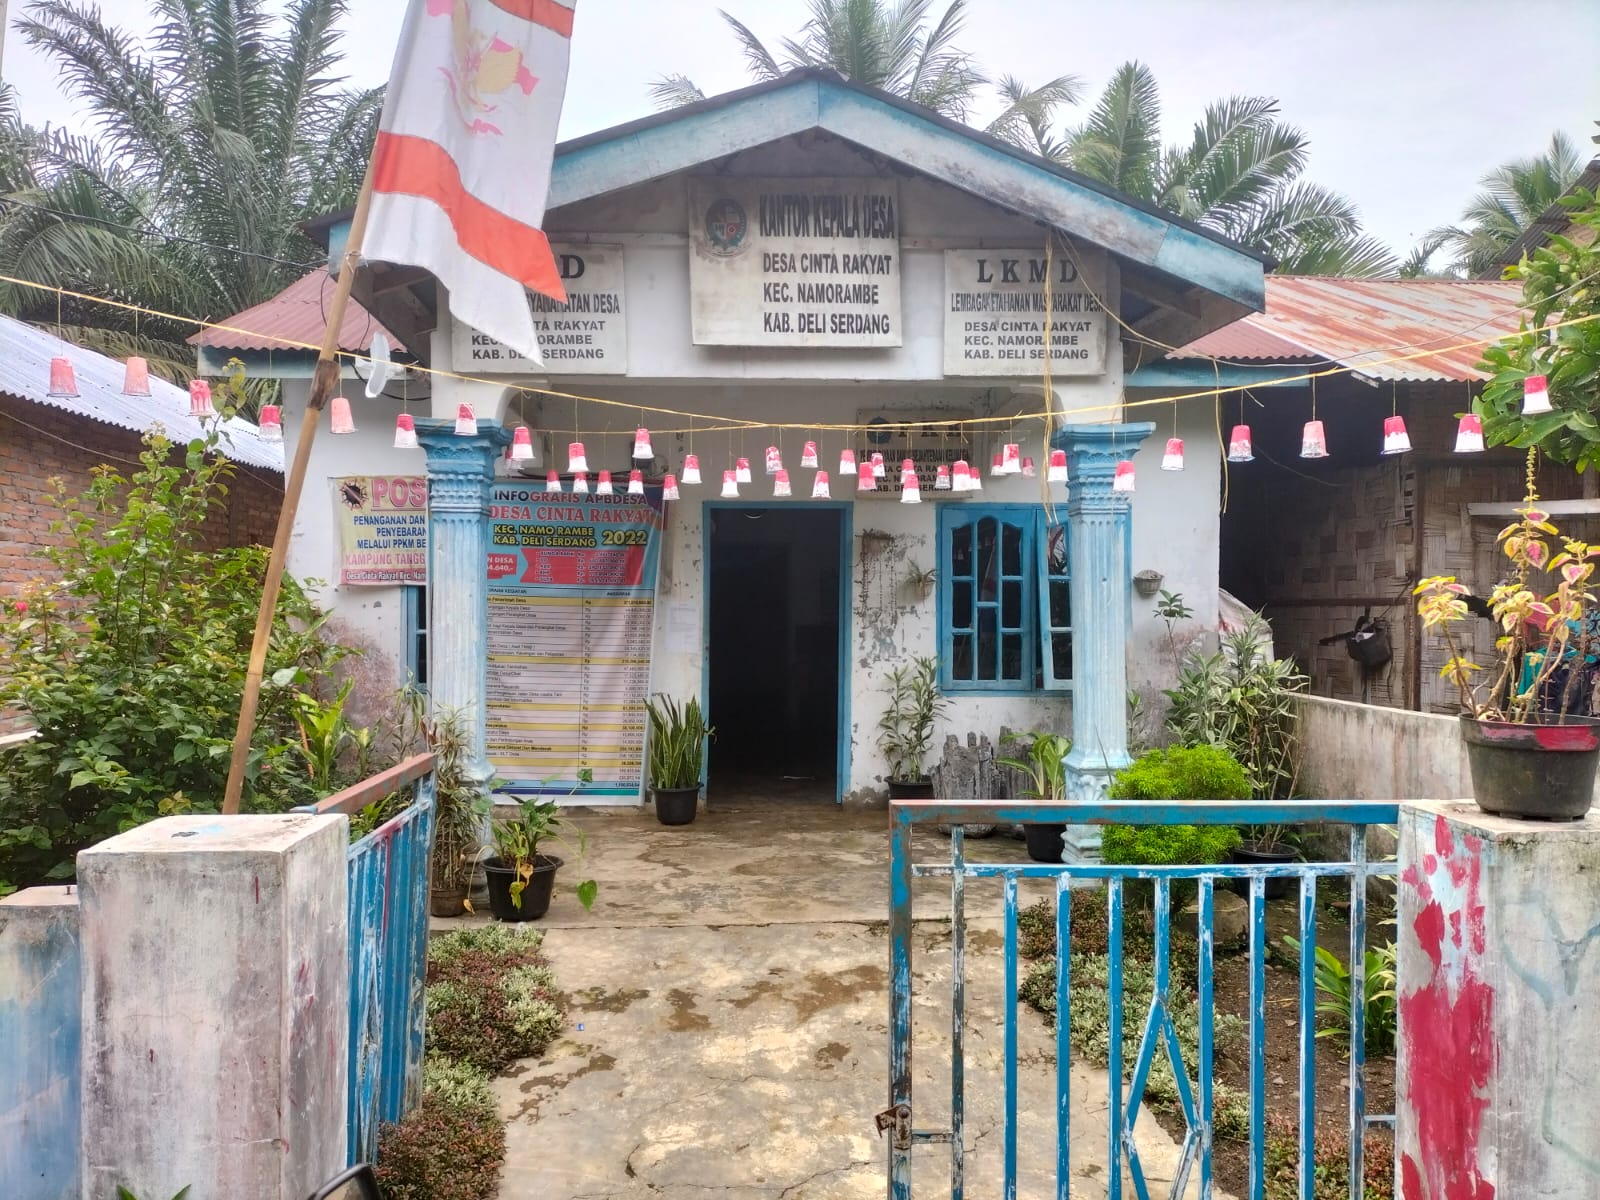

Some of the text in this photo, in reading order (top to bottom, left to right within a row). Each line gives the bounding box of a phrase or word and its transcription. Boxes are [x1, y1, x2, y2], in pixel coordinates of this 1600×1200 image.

[759, 195, 895, 239] KANTOR KEPALA DESA
[763, 253, 892, 275] DESA CINTA RAKYAT
[763, 283, 879, 305] KEC. NAMORAMBE
[593, 294, 621, 314] DESA
[554, 320, 606, 331] RAKYAT
[763, 312, 890, 334] KAB. DELI SERDANG
[964, 322, 998, 332] DESA
[1001, 322, 1039, 332] CINTA
[964, 335, 994, 346] KEC.
[472, 349, 505, 360] KAB.
[542, 349, 604, 359] SERDANG
[964, 349, 1089, 360] KAB. DELI SERDANG
[494, 490, 580, 504] INFOGRAFIS
[353, 515, 426, 525] PENANGANAN DAN
[489, 505, 652, 523] DESA CINTA RAKYAT
[494, 525, 594, 537] KEC. NAMO RAMBE
[357, 539, 391, 549] MELALUI
[393, 539, 414, 549] PPKM
[494, 535, 597, 547] KAB. DELI SERDANG
[602, 530, 648, 546] 2022
[345, 553, 393, 565] KAMPUNG
